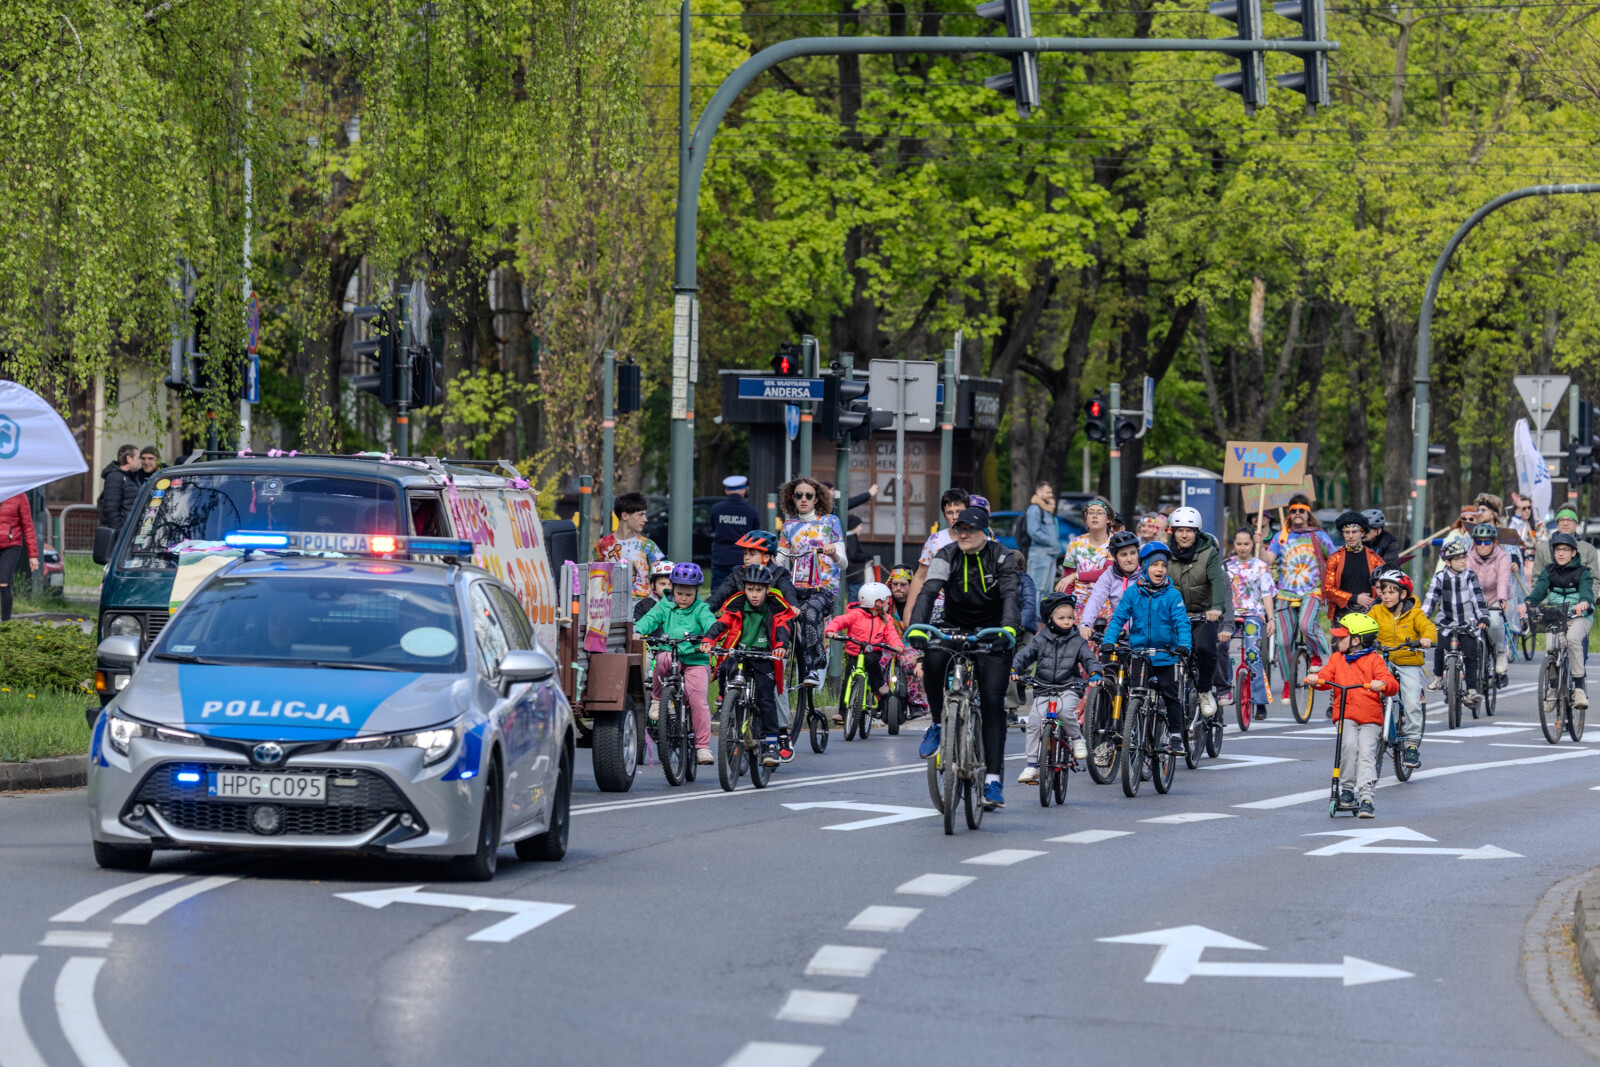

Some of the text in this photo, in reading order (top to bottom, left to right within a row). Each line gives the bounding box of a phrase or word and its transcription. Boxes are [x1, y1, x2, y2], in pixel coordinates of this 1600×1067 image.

[764, 387, 810, 397] ANDERSA
[1233, 447, 1266, 463] Velo
[1242, 463, 1279, 479] Huta
[719, 515, 747, 525] POLICJA
[304, 535, 368, 550] POLICJA
[201, 700, 351, 724] POLICJA
[222, 775, 320, 797] HPG C095
